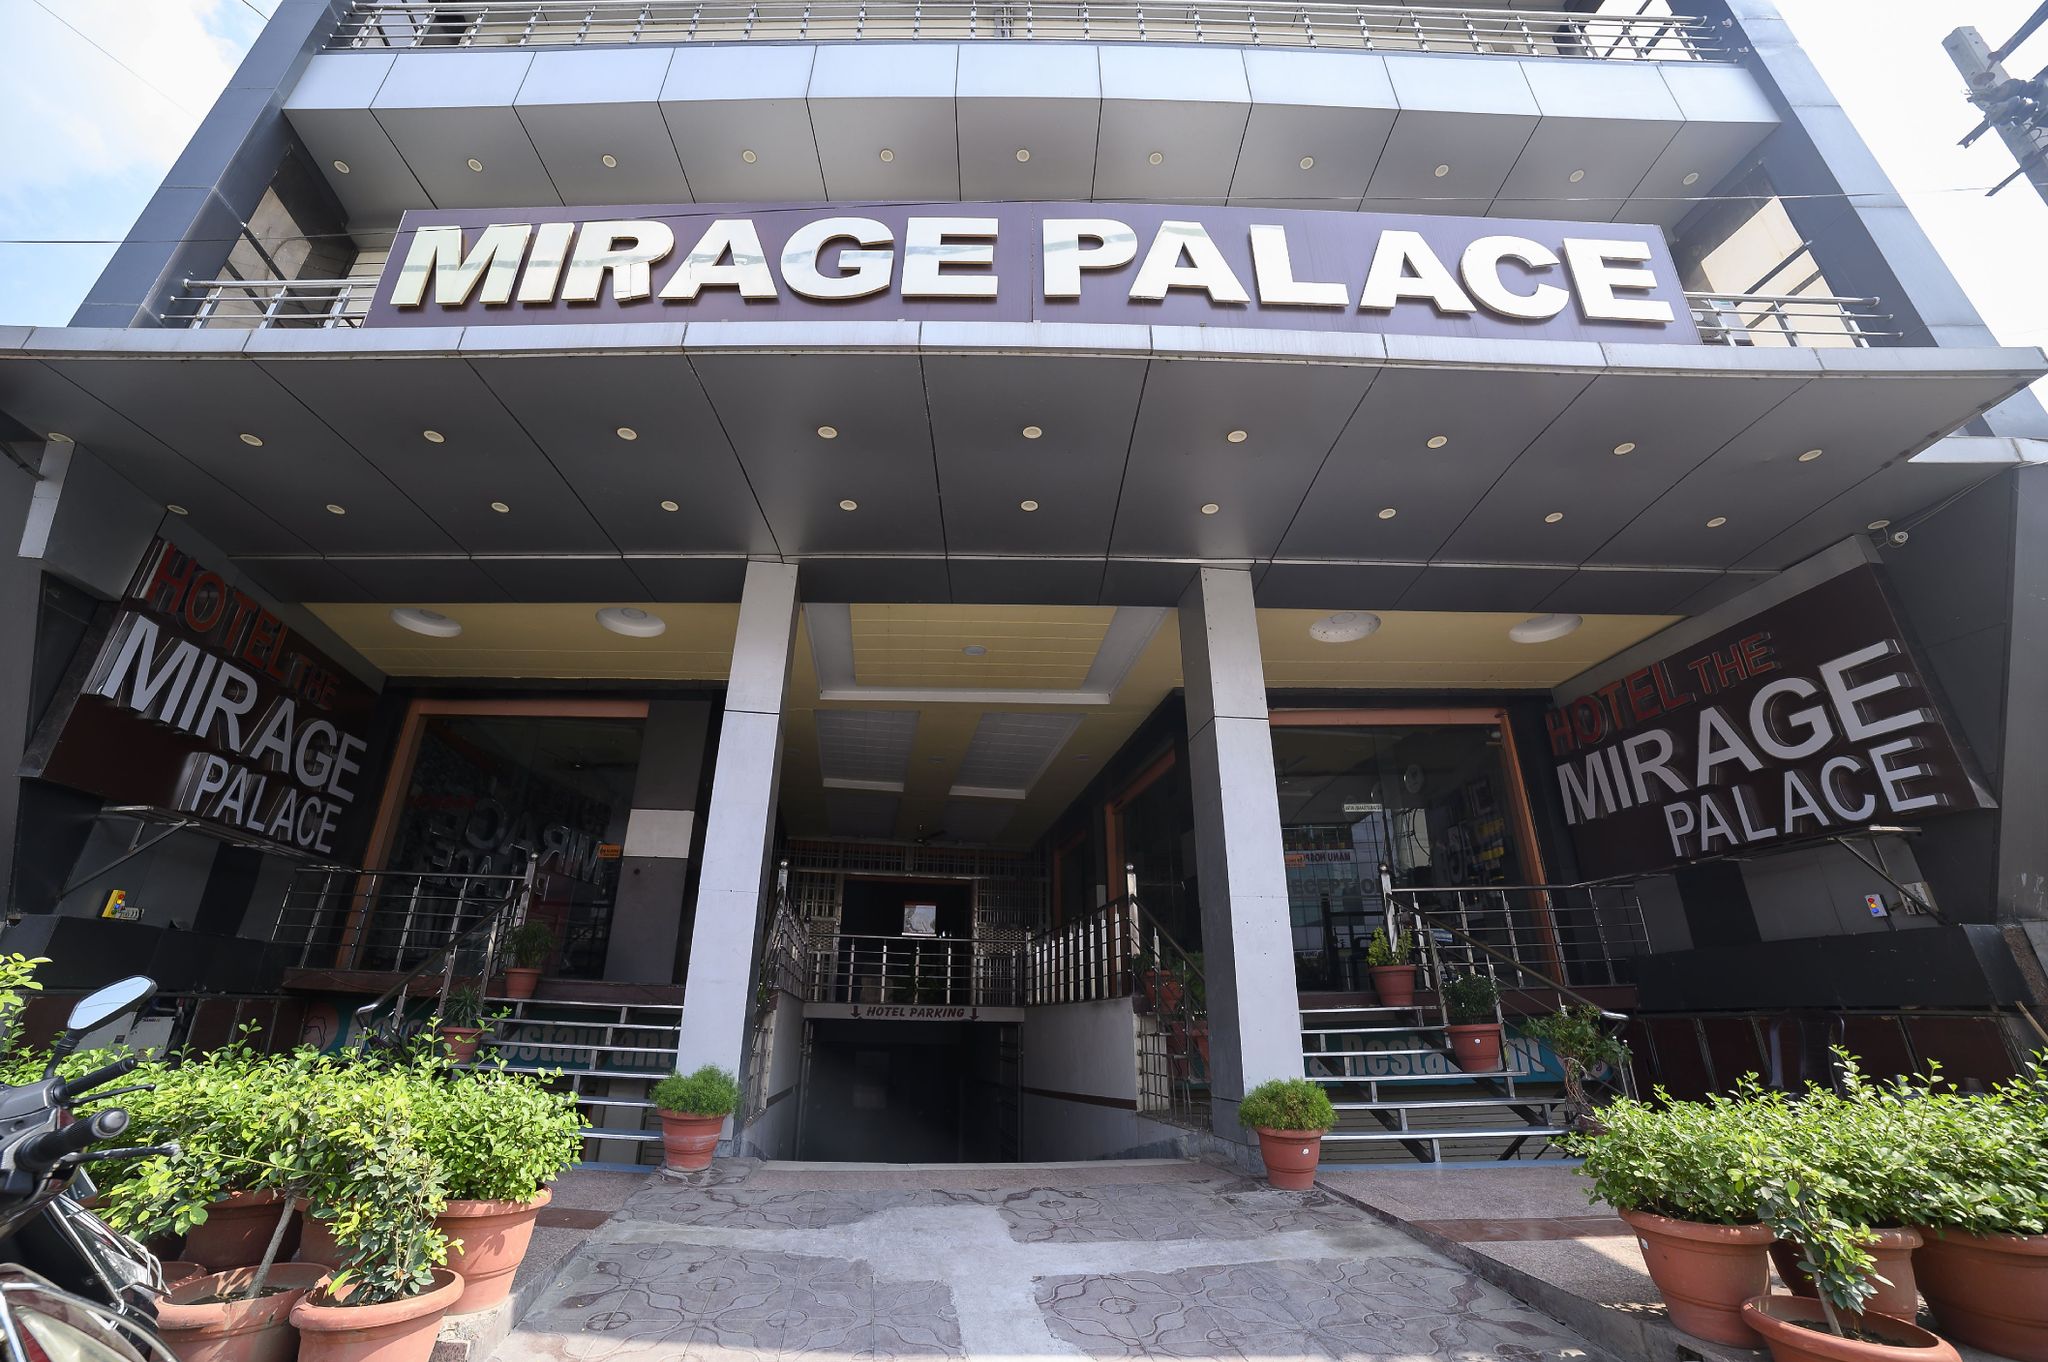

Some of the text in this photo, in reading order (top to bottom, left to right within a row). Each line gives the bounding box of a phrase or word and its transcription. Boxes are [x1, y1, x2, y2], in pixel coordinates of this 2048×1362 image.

[388, 217, 1675, 324] MIRAGE PALACE
[145, 543, 343, 711] HOTEL THE
[101, 614, 369, 803] MIRAGE
[1545, 632, 1778, 756] HOTEL THE
[1556, 640, 1927, 826] MIRAGE
[190, 754, 343, 854] PALACE
[1663, 738, 1939, 858] PALACE
[867, 1006, 965, 1019] HOTEL PARKING
